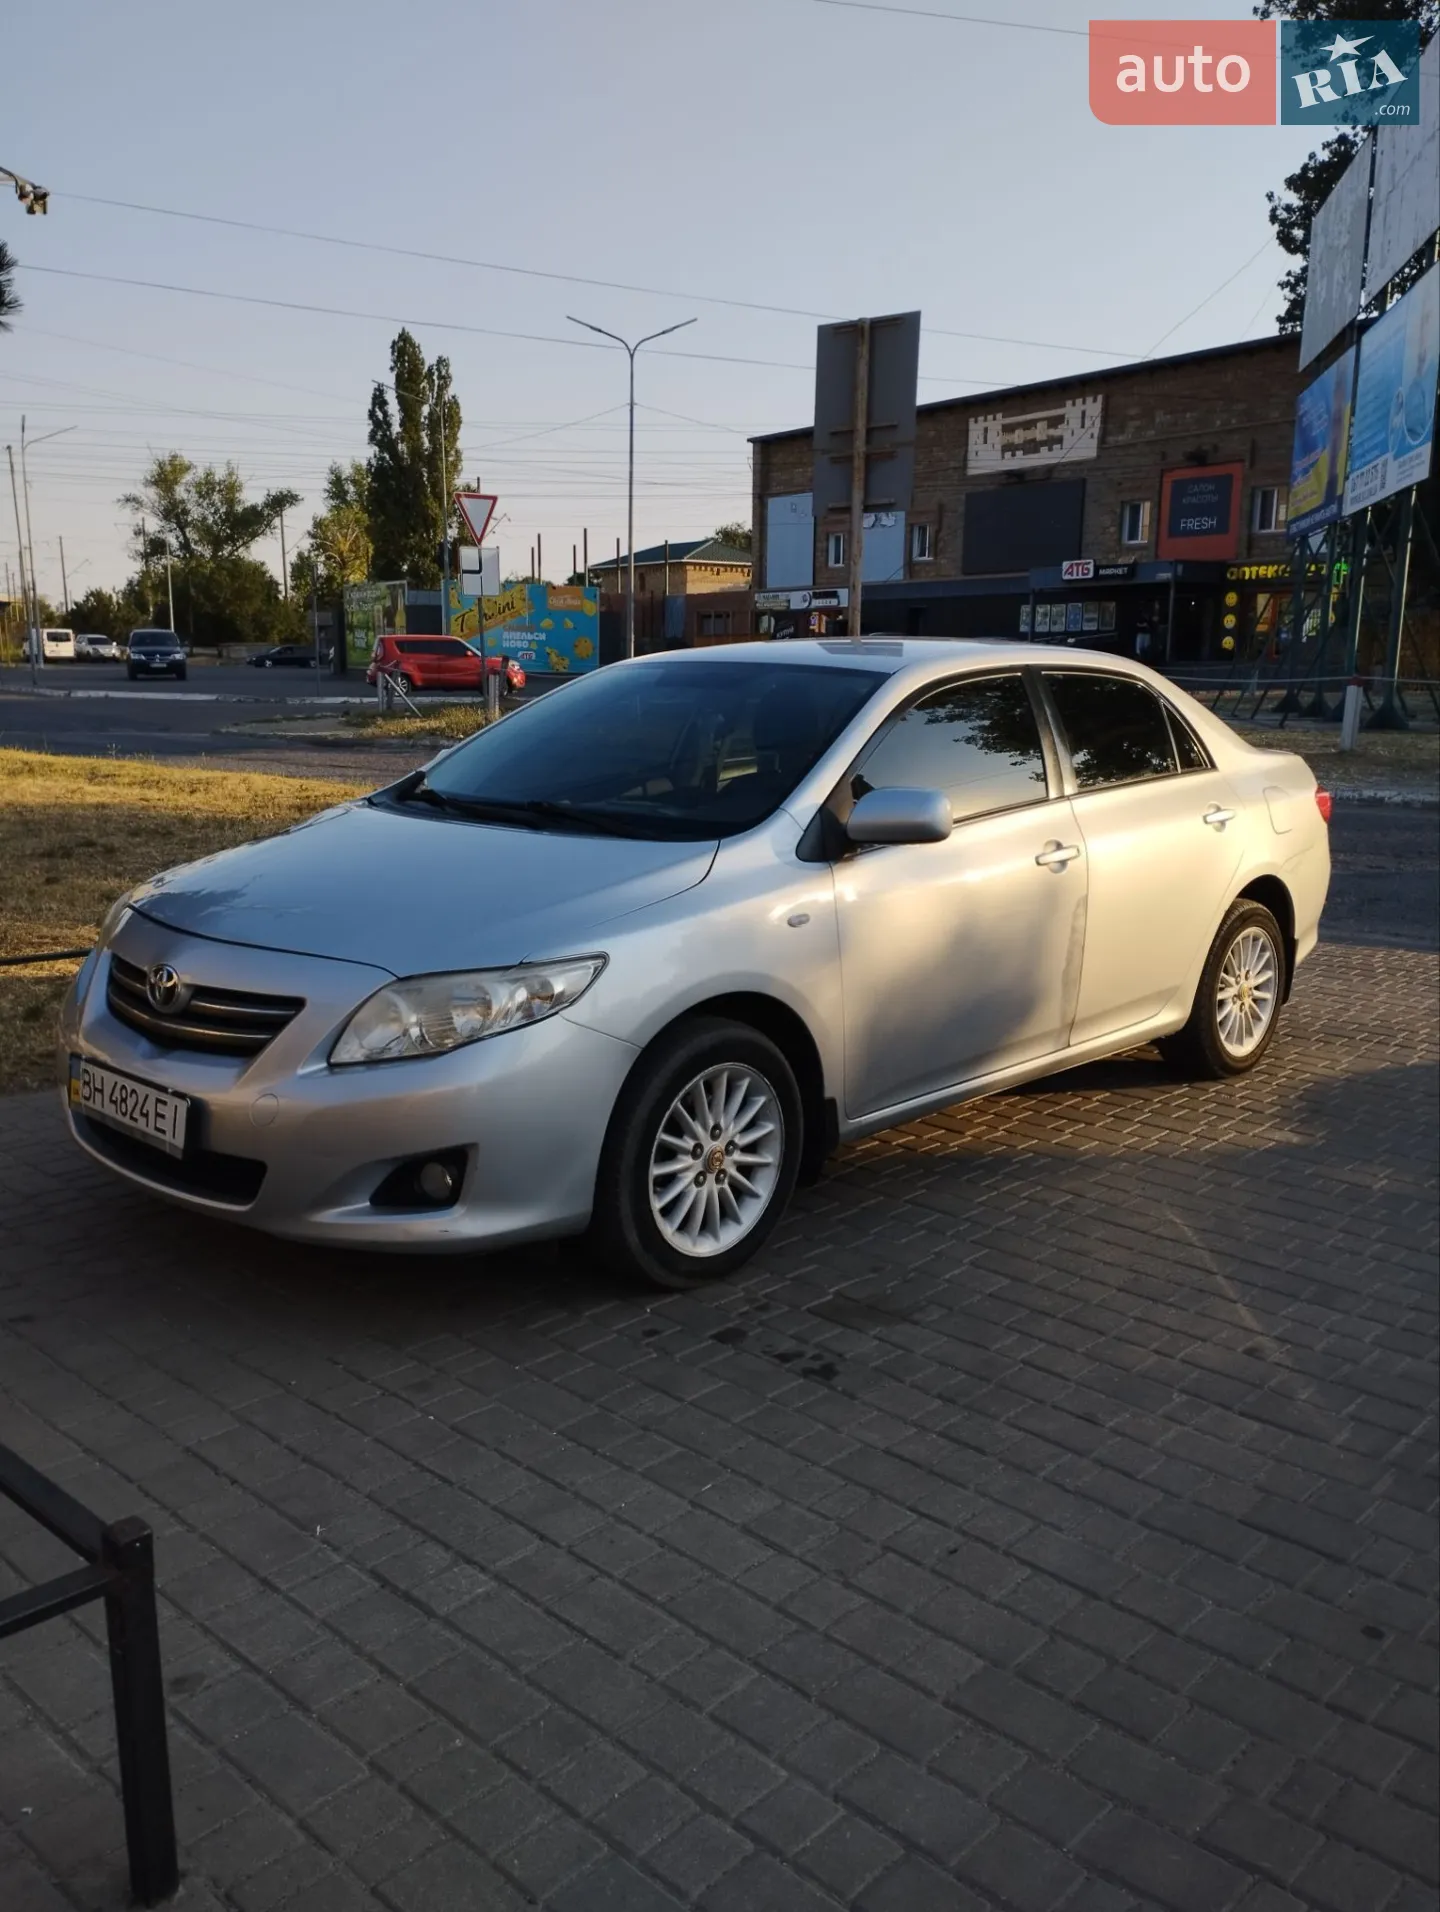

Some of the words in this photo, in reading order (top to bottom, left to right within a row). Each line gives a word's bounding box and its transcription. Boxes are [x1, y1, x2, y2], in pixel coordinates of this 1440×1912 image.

[1180, 516, 1217, 530] FRESH
[1064, 562, 1092, 577] АТБ
[109, 1080, 150, 1129] 4824
